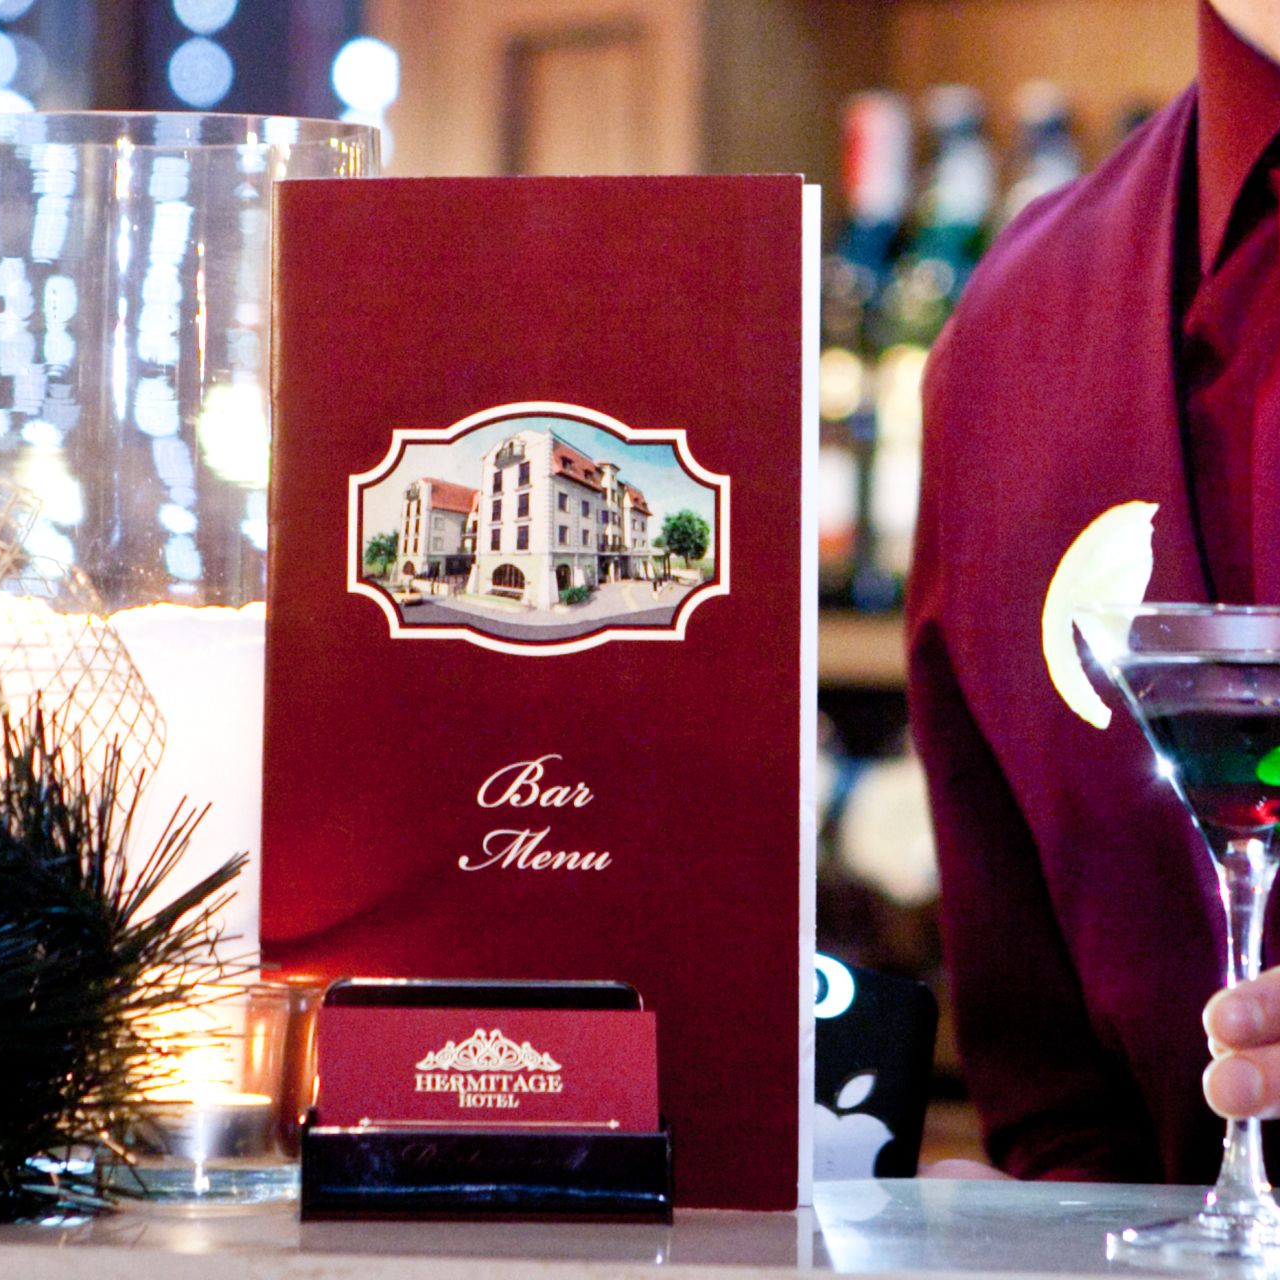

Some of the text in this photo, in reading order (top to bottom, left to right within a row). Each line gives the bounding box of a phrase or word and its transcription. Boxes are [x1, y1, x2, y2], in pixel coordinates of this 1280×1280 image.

[477, 753, 594, 808] Bar
[459, 826, 611, 871] Menu
[414, 1073, 564, 1094] HERMITAGE
[458, 1093, 520, 1109] HOTEL
